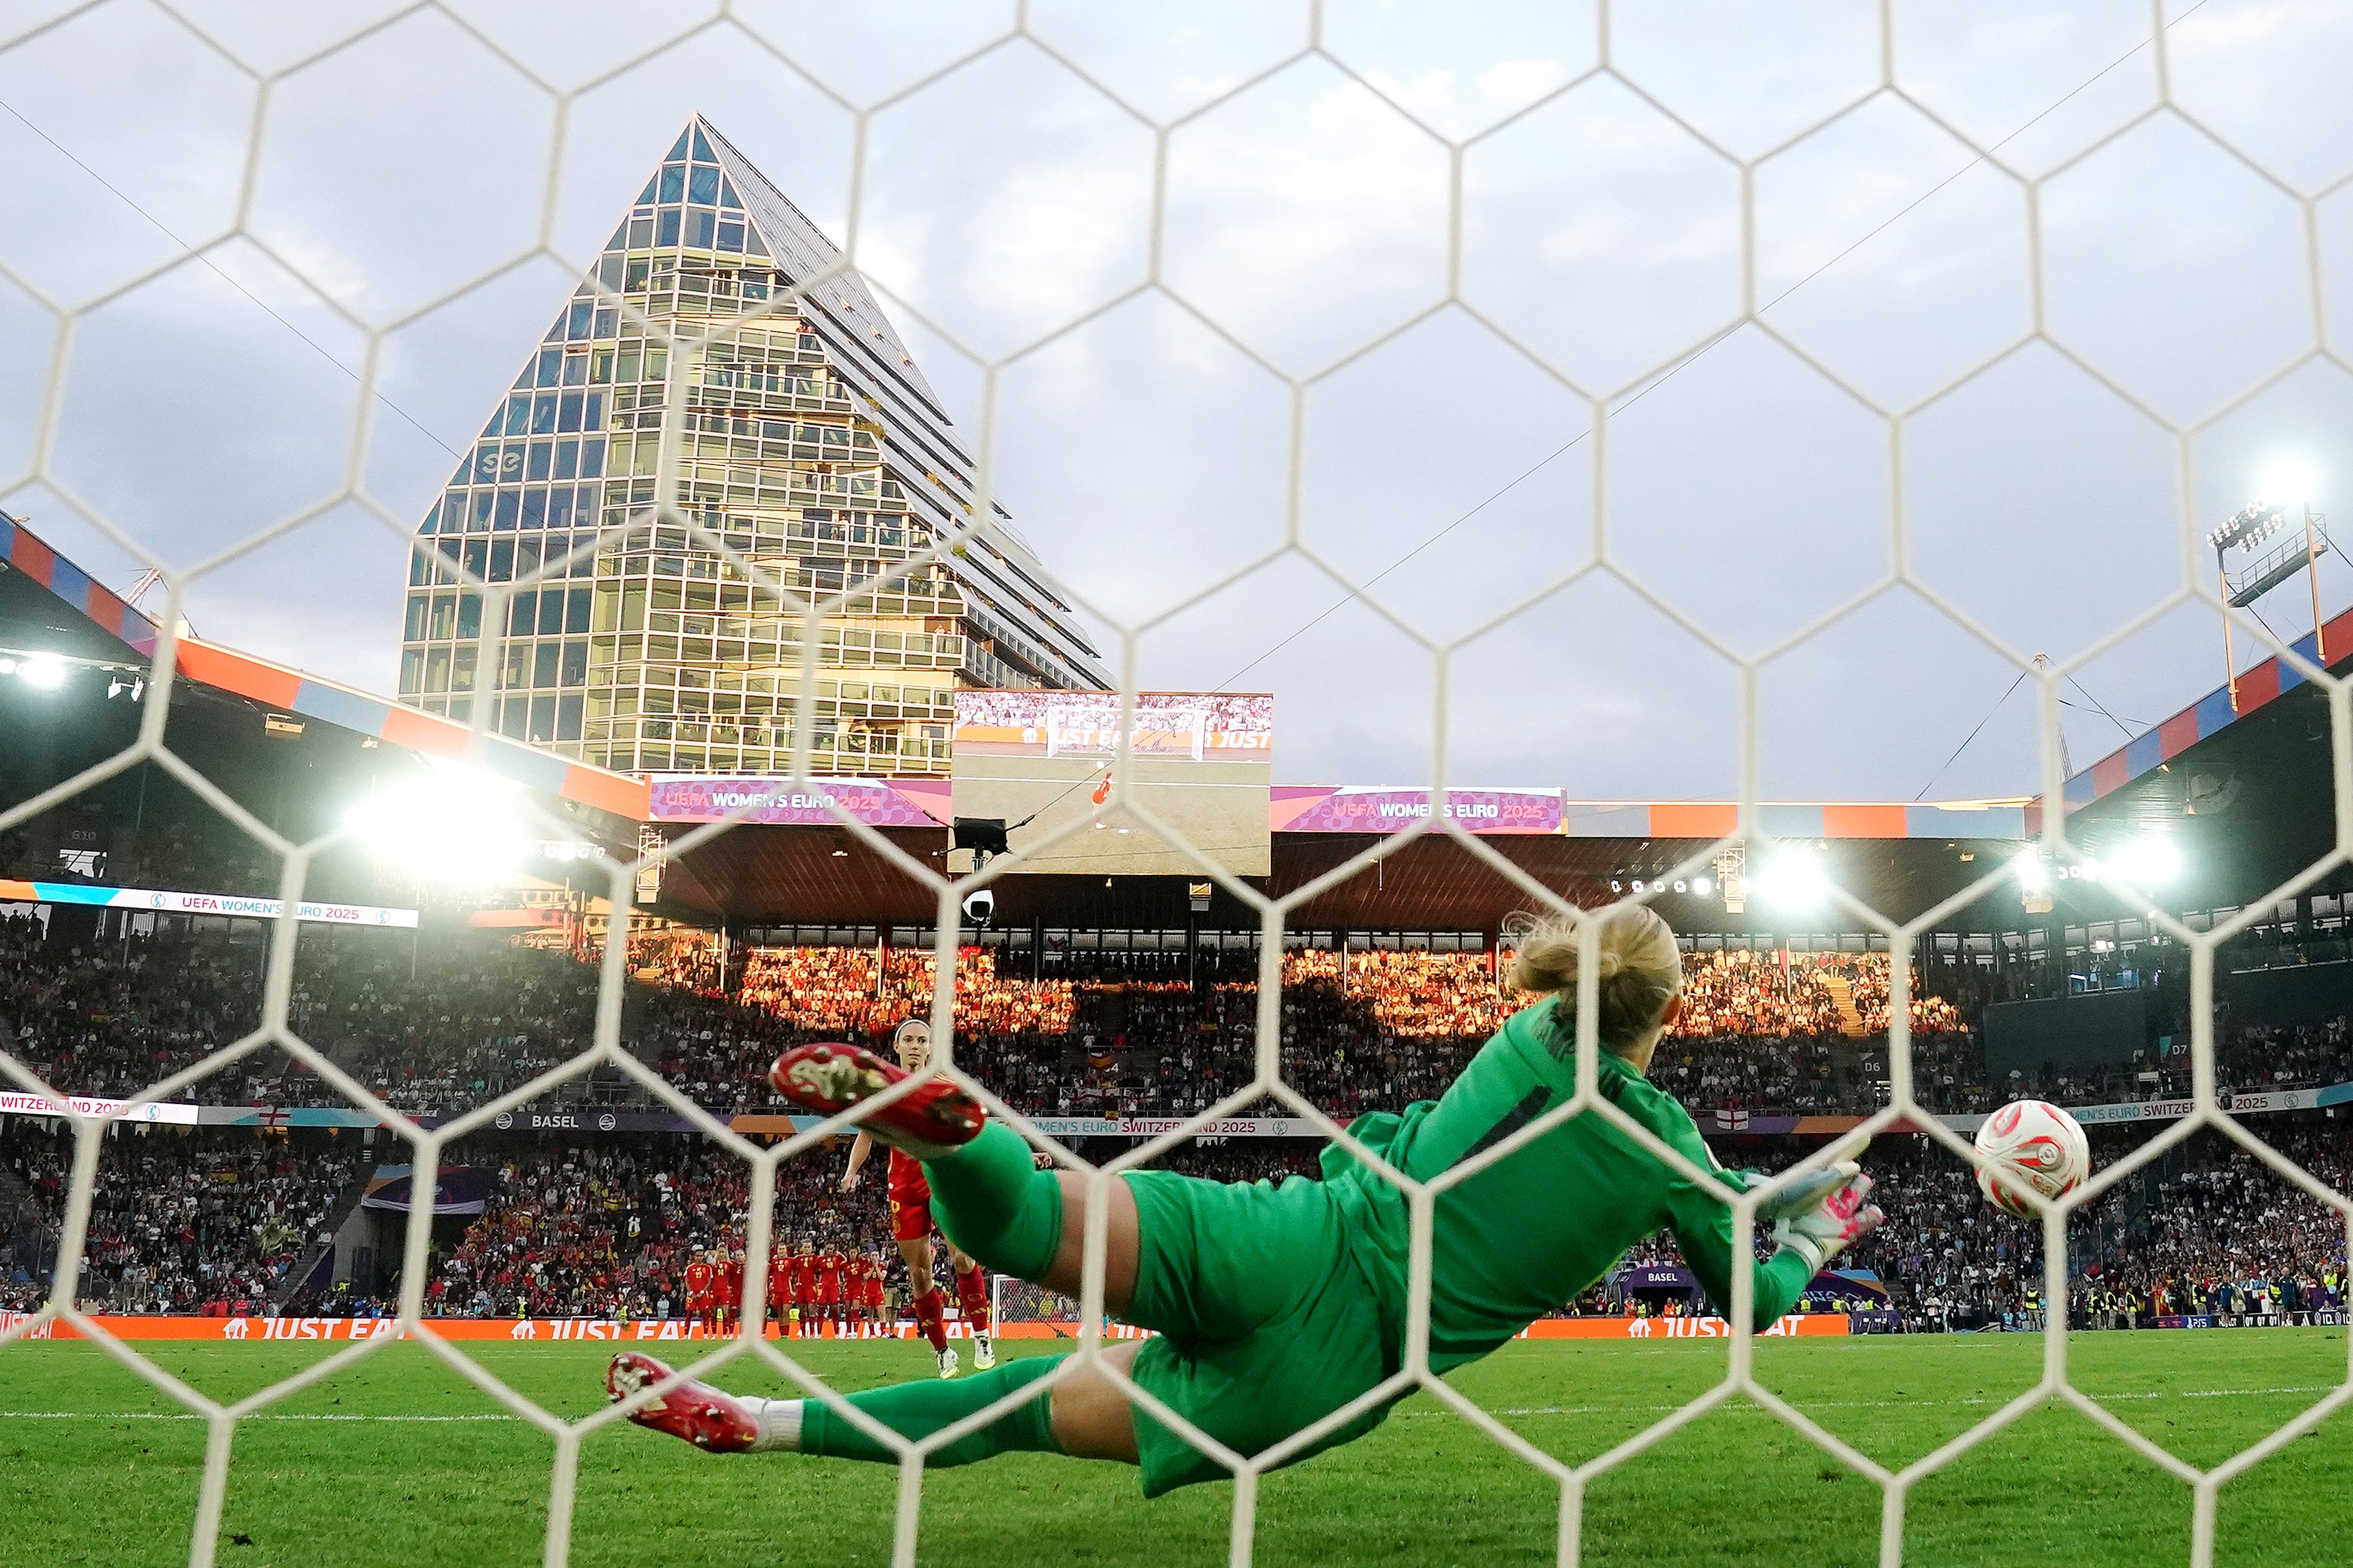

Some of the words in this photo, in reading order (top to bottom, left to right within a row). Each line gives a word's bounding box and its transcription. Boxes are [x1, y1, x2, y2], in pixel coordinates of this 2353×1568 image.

[1056, 729, 1095, 746] UST
[1219, 731, 1272, 748] JUST
[666, 792, 709, 806] UEFA
[791, 794, 836, 809] EURO
[839, 796, 881, 809] 2025
[1334, 803, 1378, 818] UEFA
[1379, 803, 1453, 818] WOMES
[1456, 804, 1498, 818] EURO
[1502, 805, 1544, 818] 2025
[182, 897, 218, 909] UEFA
[221, 900, 282, 915] WOMEN'S
[295, 905, 321, 918] URO
[326, 908, 359, 920] 2025
[2172, 1044, 2187, 1055] D7
[1864, 1062, 1881, 1072] D6
[2236, 1097, 2269, 1110] 2025
[532, 1115, 579, 1129] BASEL
[1032, 1121, 1078, 1132] MEN'S
[1082, 1121, 1119, 1133] EURO
[1122, 1121, 1218, 1133] SWITZERND
[1222, 1122, 1256, 1133] 2025
[1648, 1273, 1678, 1282] BASEL
[263, 1318, 341, 1340] JUST
[549, 1321, 622, 1340] JUST
[636, 1321, 701, 1340] EAT
[1663, 1317, 1730, 1338] JUST
[2193, 1318, 2207, 1328] PS5
